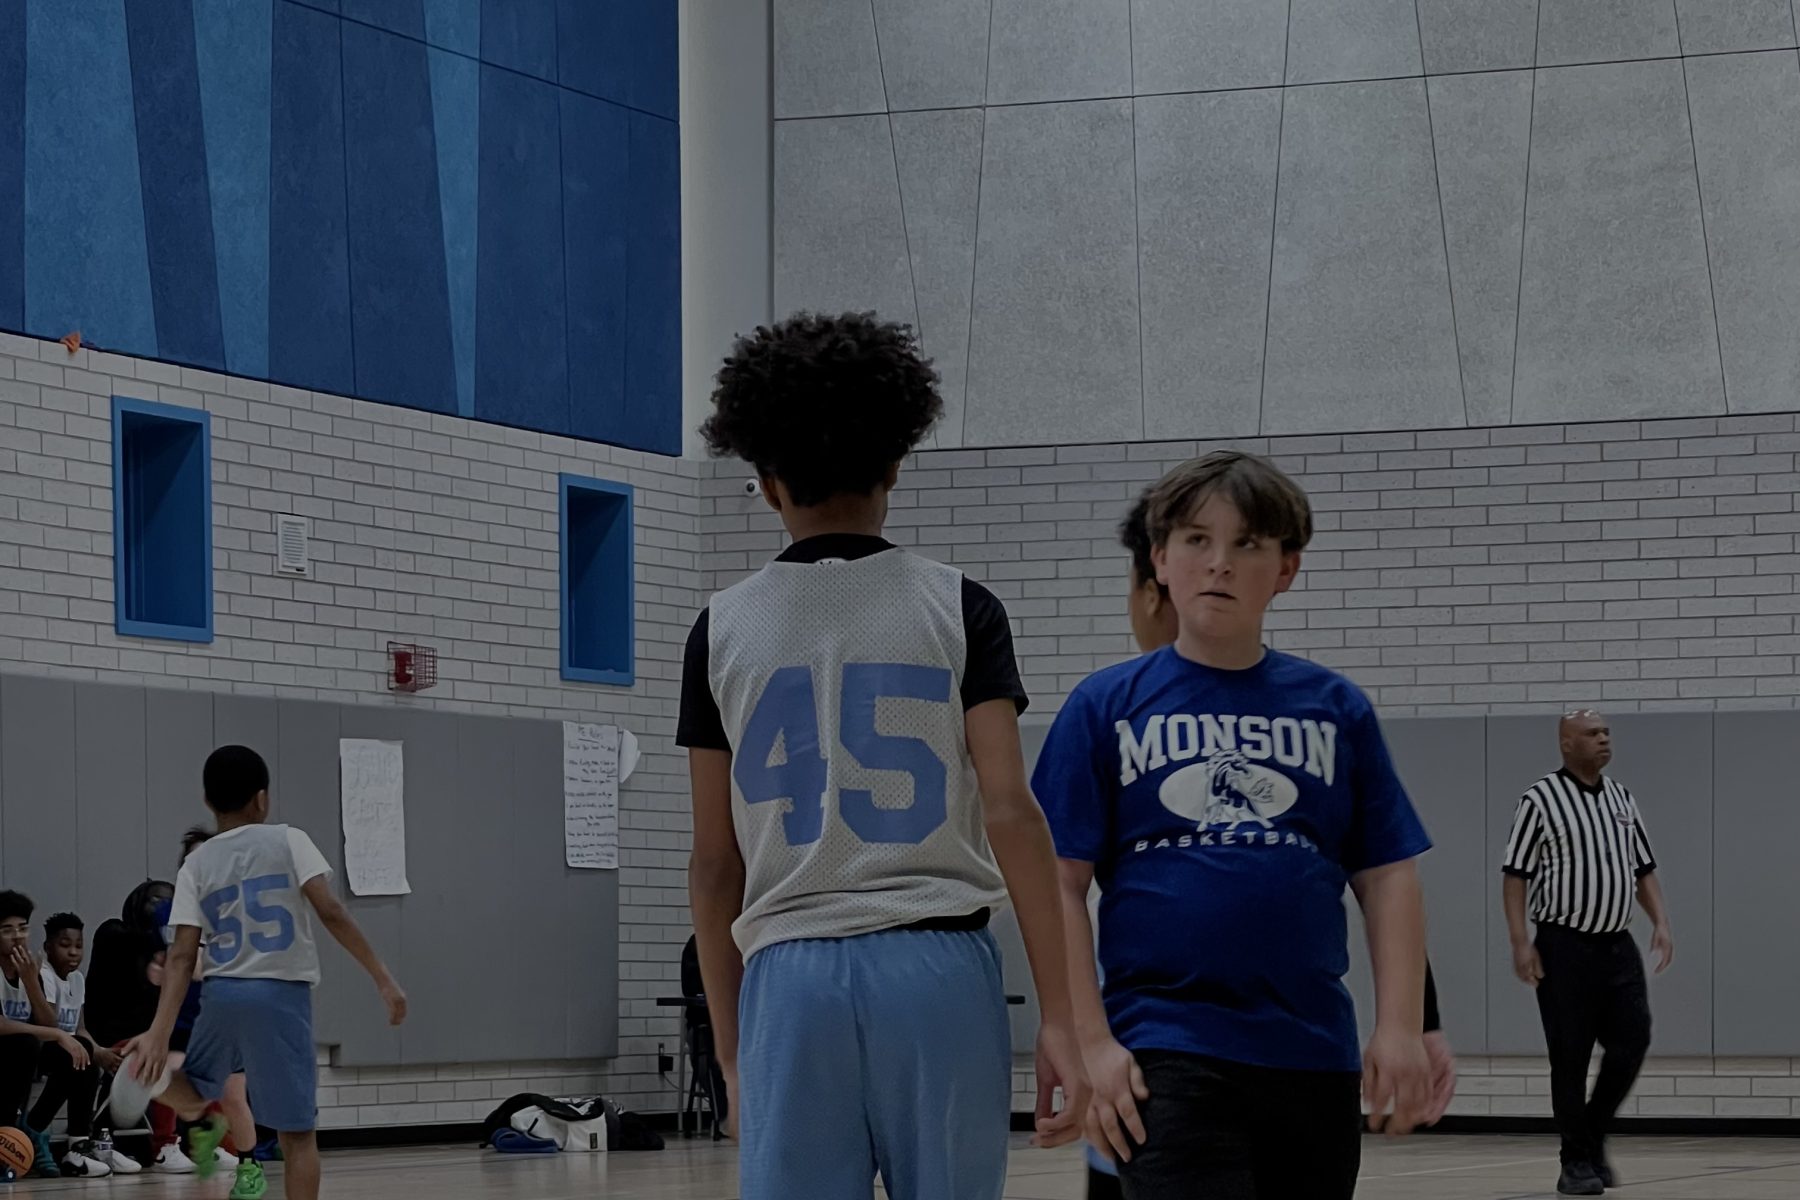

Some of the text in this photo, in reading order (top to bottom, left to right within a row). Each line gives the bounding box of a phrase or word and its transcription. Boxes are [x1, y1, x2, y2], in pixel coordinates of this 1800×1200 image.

[734, 663, 952, 846] 45
[1115, 714, 1337, 786] MONSON
[200, 873, 295, 964] 55
